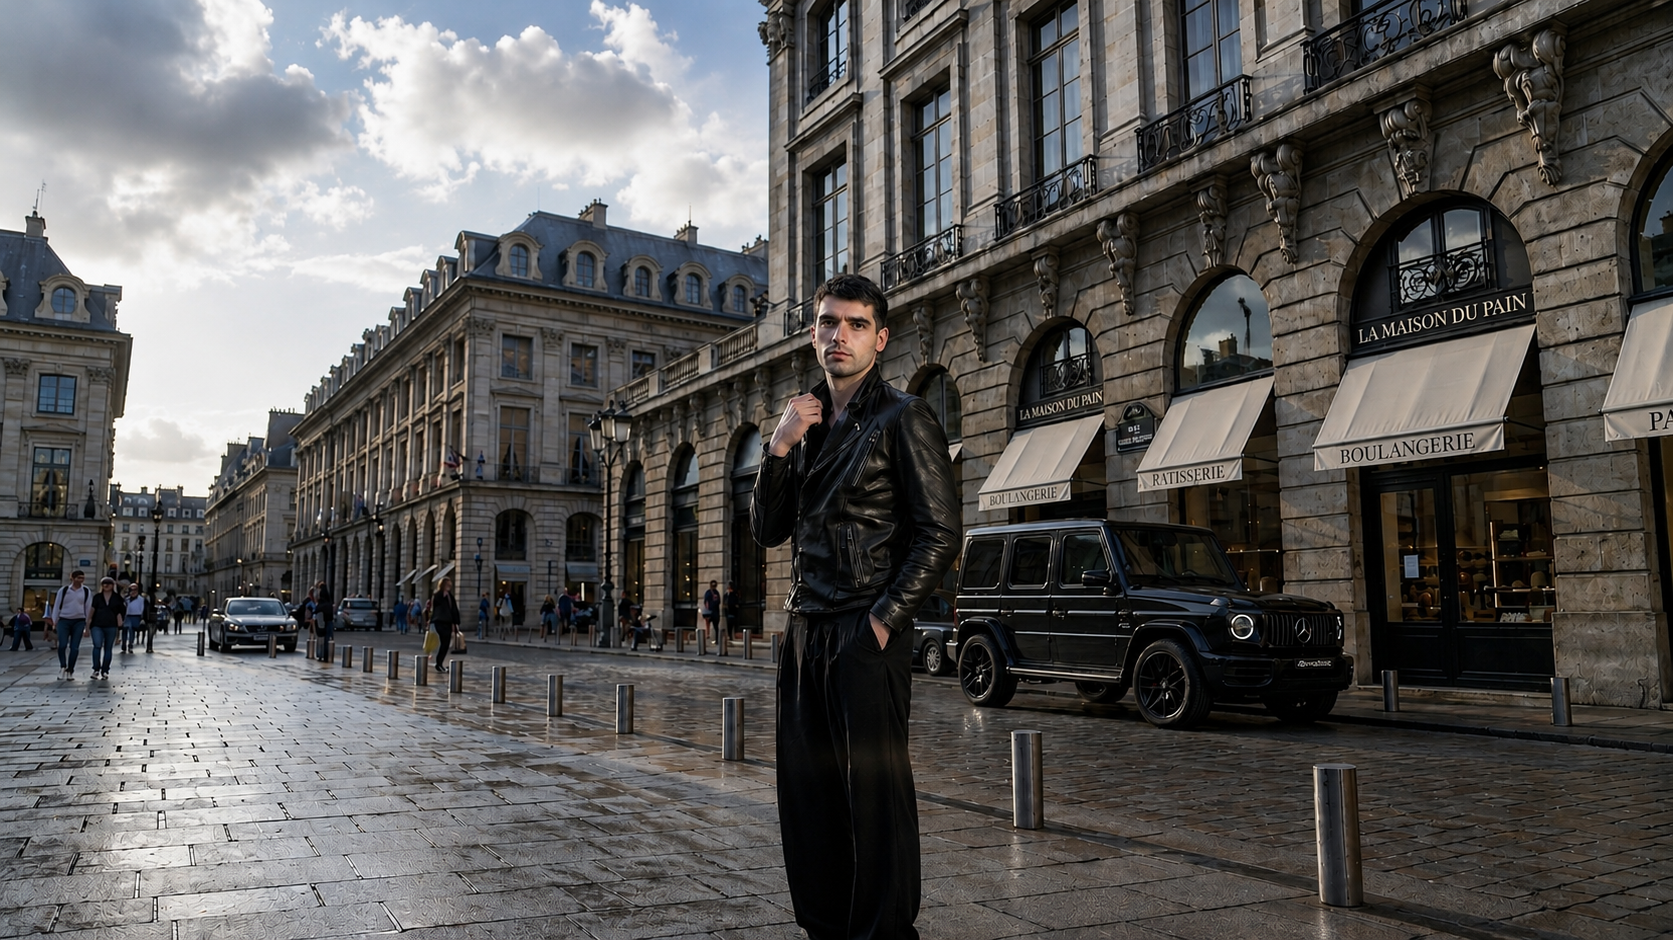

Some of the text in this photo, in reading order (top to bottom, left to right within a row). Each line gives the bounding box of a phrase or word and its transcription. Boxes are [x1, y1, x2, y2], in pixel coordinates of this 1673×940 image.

[1358, 292, 1527, 344] LA MAISON DU PAIN
[1019, 390, 1104, 421] LA MAISON DU PAIN
[1340, 432, 1476, 465] BOULANGERIE
[1152, 464, 1226, 487] RATISSERIE
[989, 486, 1058, 506] BOULANGERIE
